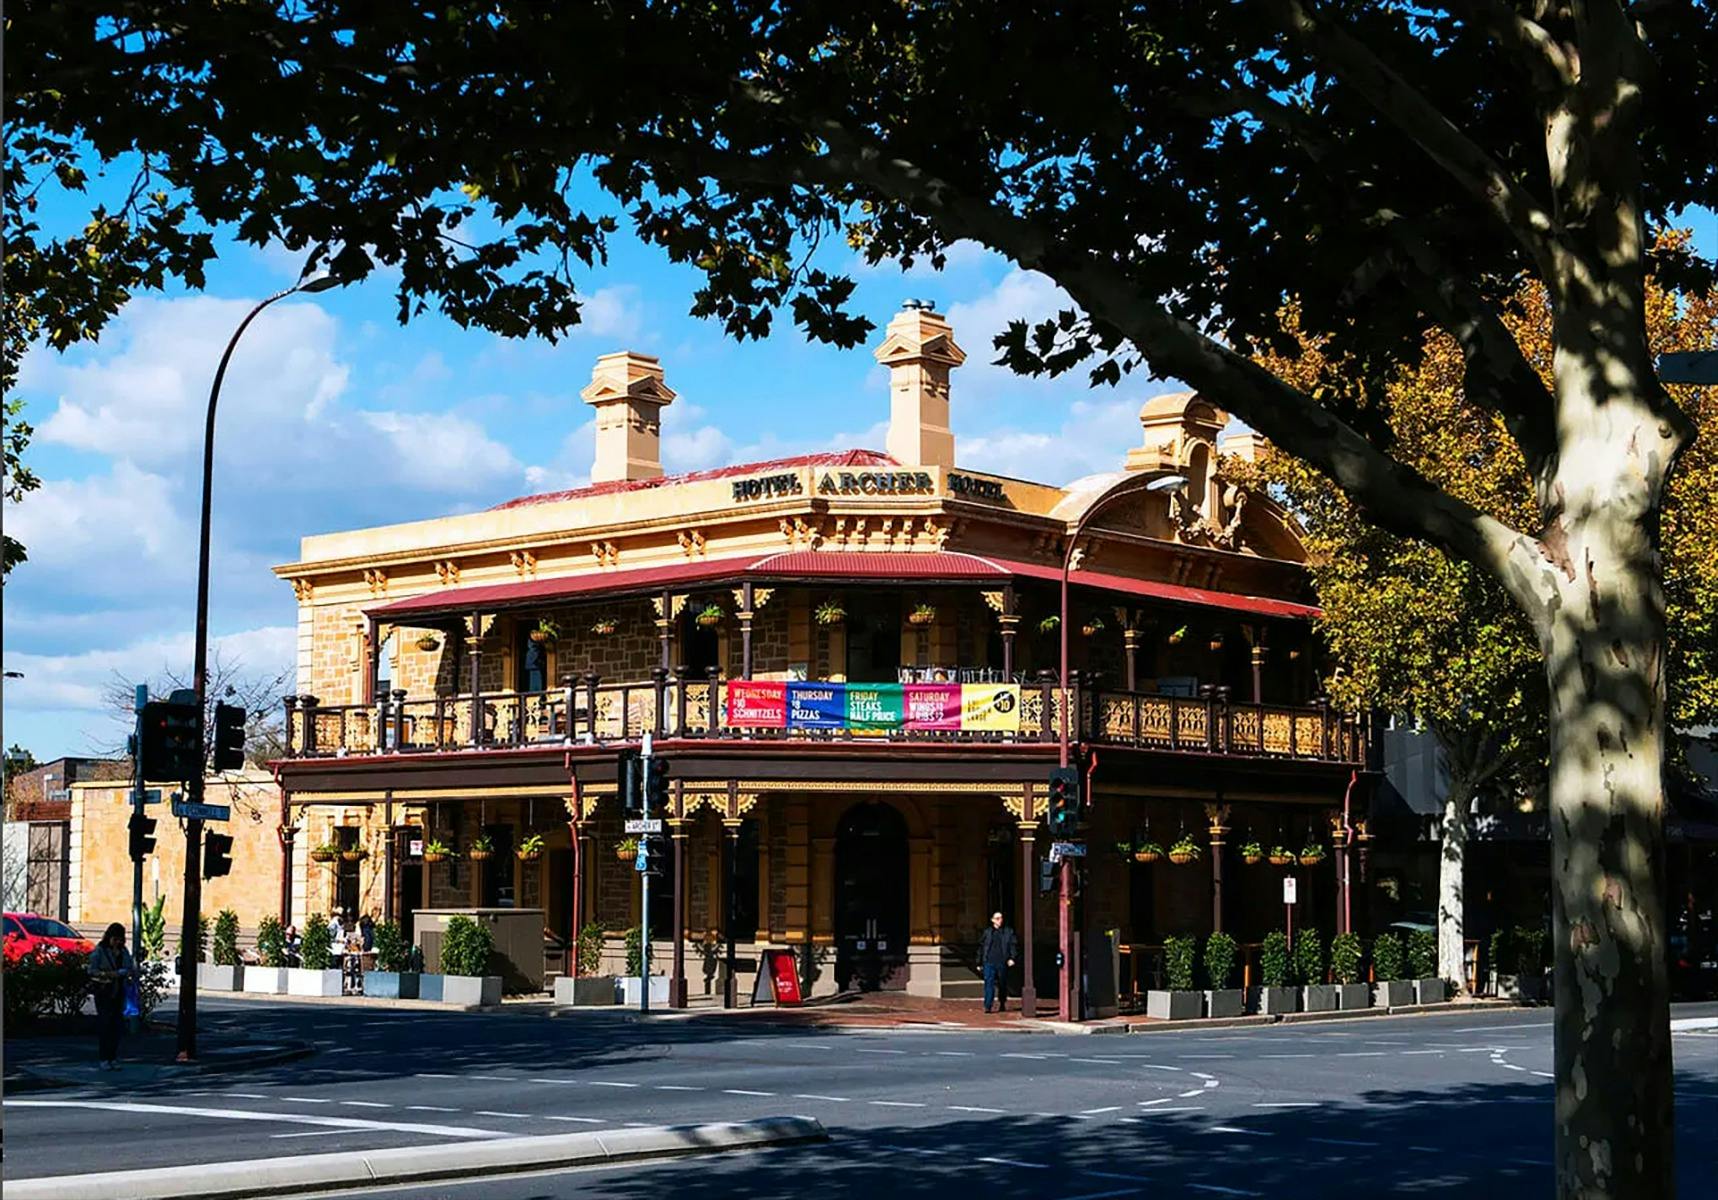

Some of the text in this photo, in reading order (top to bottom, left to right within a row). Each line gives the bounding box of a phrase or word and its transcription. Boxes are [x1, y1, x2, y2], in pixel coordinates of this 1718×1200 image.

[732, 473, 802, 501] HOTEL
[817, 471, 935, 496] ARCHER
[947, 473, 1007, 502] HOTEL
[733, 688, 782, 699] WEDNESDAY
[791, 690, 833, 701] THURSDAY
[850, 691, 878, 701] FRIDAY
[909, 691, 950, 702] SATURDAY
[850, 701, 882, 711] STEAKS
[733, 708, 782, 719] SCHNITZELS
[791, 709, 820, 720] PIZZAS
[850, 711, 897, 722] HALF PRICE
